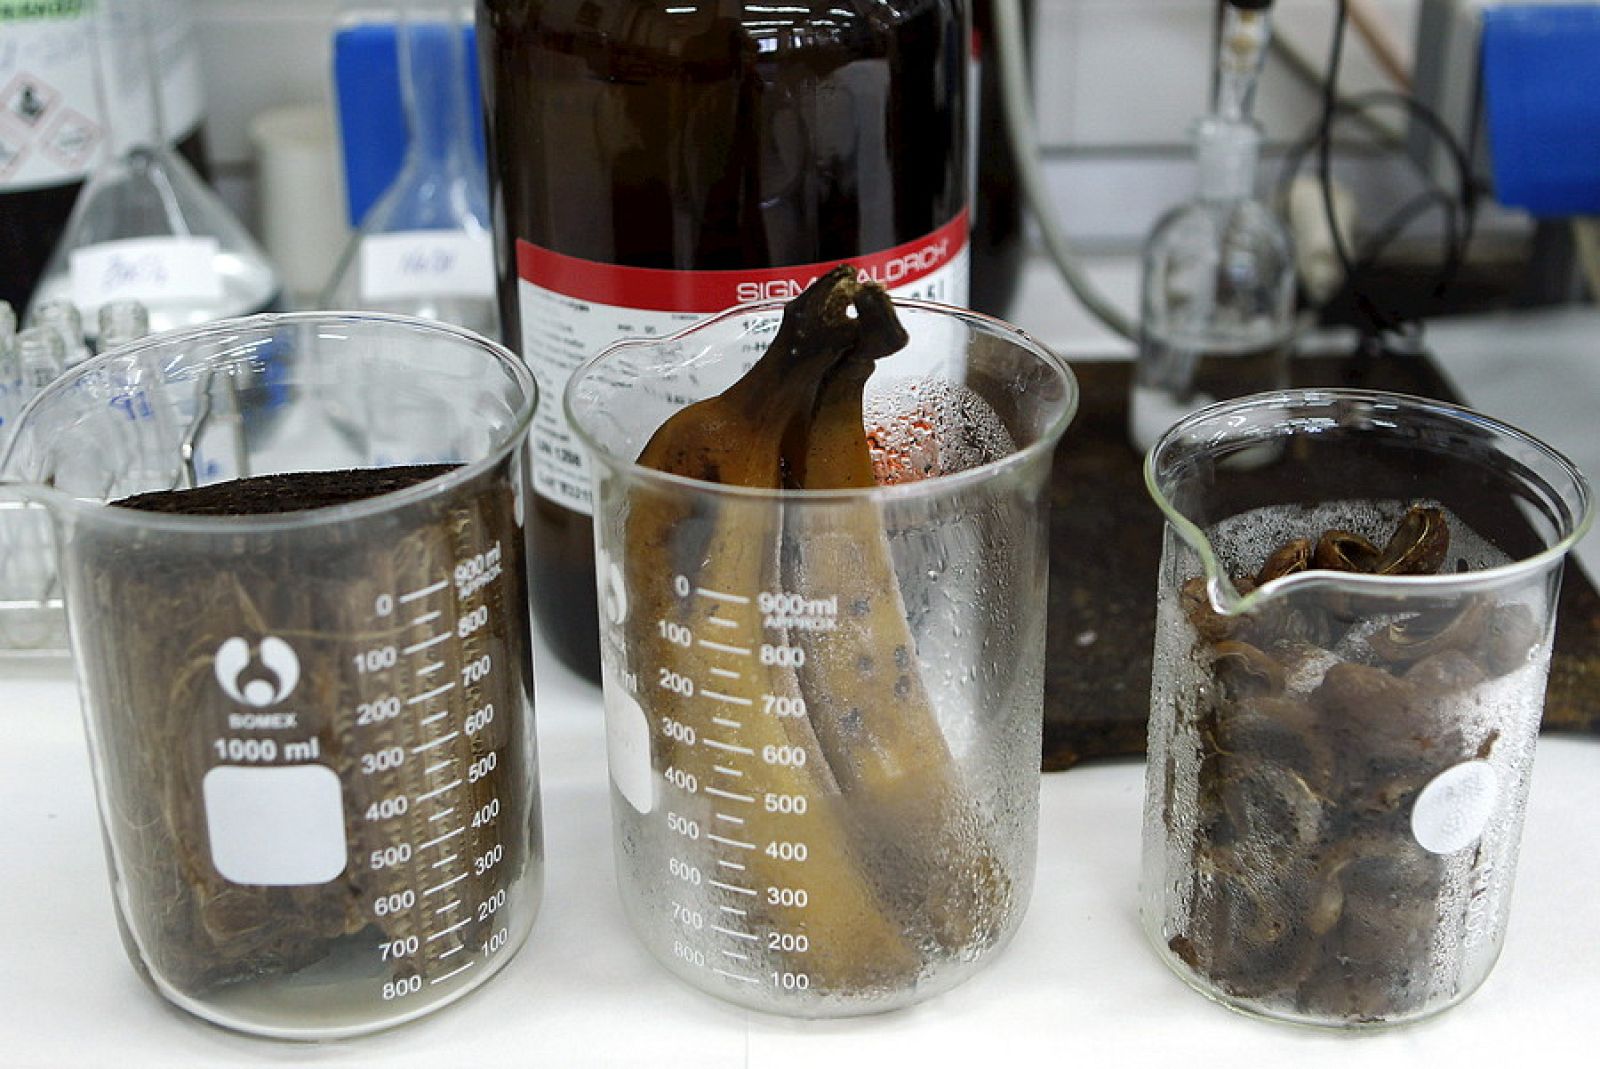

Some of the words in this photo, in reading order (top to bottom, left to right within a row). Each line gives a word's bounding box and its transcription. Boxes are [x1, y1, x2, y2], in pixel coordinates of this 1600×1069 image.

[736, 277, 820, 302] SIGM
[674, 574, 690, 597] 0
[375, 594, 393, 616] 0
[758, 591, 804, 615] 900
[658, 619, 692, 647] 100
[353, 646, 397, 673] 100
[759, 644, 805, 667] 800
[461, 655, 492, 688] 700
[659, 668, 694, 697] 200
[357, 697, 401, 726] 200
[761, 695, 806, 718] 700
[464, 704, 493, 737] 600
[662, 717, 696, 746] 300
[214, 739, 277, 761] 1000
[284, 737, 319, 760] ml
[361, 747, 404, 775] 300
[762, 745, 806, 767] 600
[468, 751, 497, 784] 500
[664, 766, 698, 794] 400
[366, 795, 408, 822] 400
[471, 798, 500, 829] 400
[765, 796, 807, 814] 500
[667, 813, 701, 841] 500
[370, 843, 412, 870] 500
[474, 844, 504, 876] 300
[766, 842, 808, 862] 400
[669, 858, 702, 886] 600
[374, 890, 416, 917] 600
[477, 889, 507, 921] 200
[767, 887, 808, 908] 300
[671, 901, 703, 930] 700
[378, 935, 420, 962] 700
[481, 927, 509, 958] 100
[768, 933, 808, 953] 200
[382, 975, 422, 1000] 800
[771, 972, 810, 990] 100
